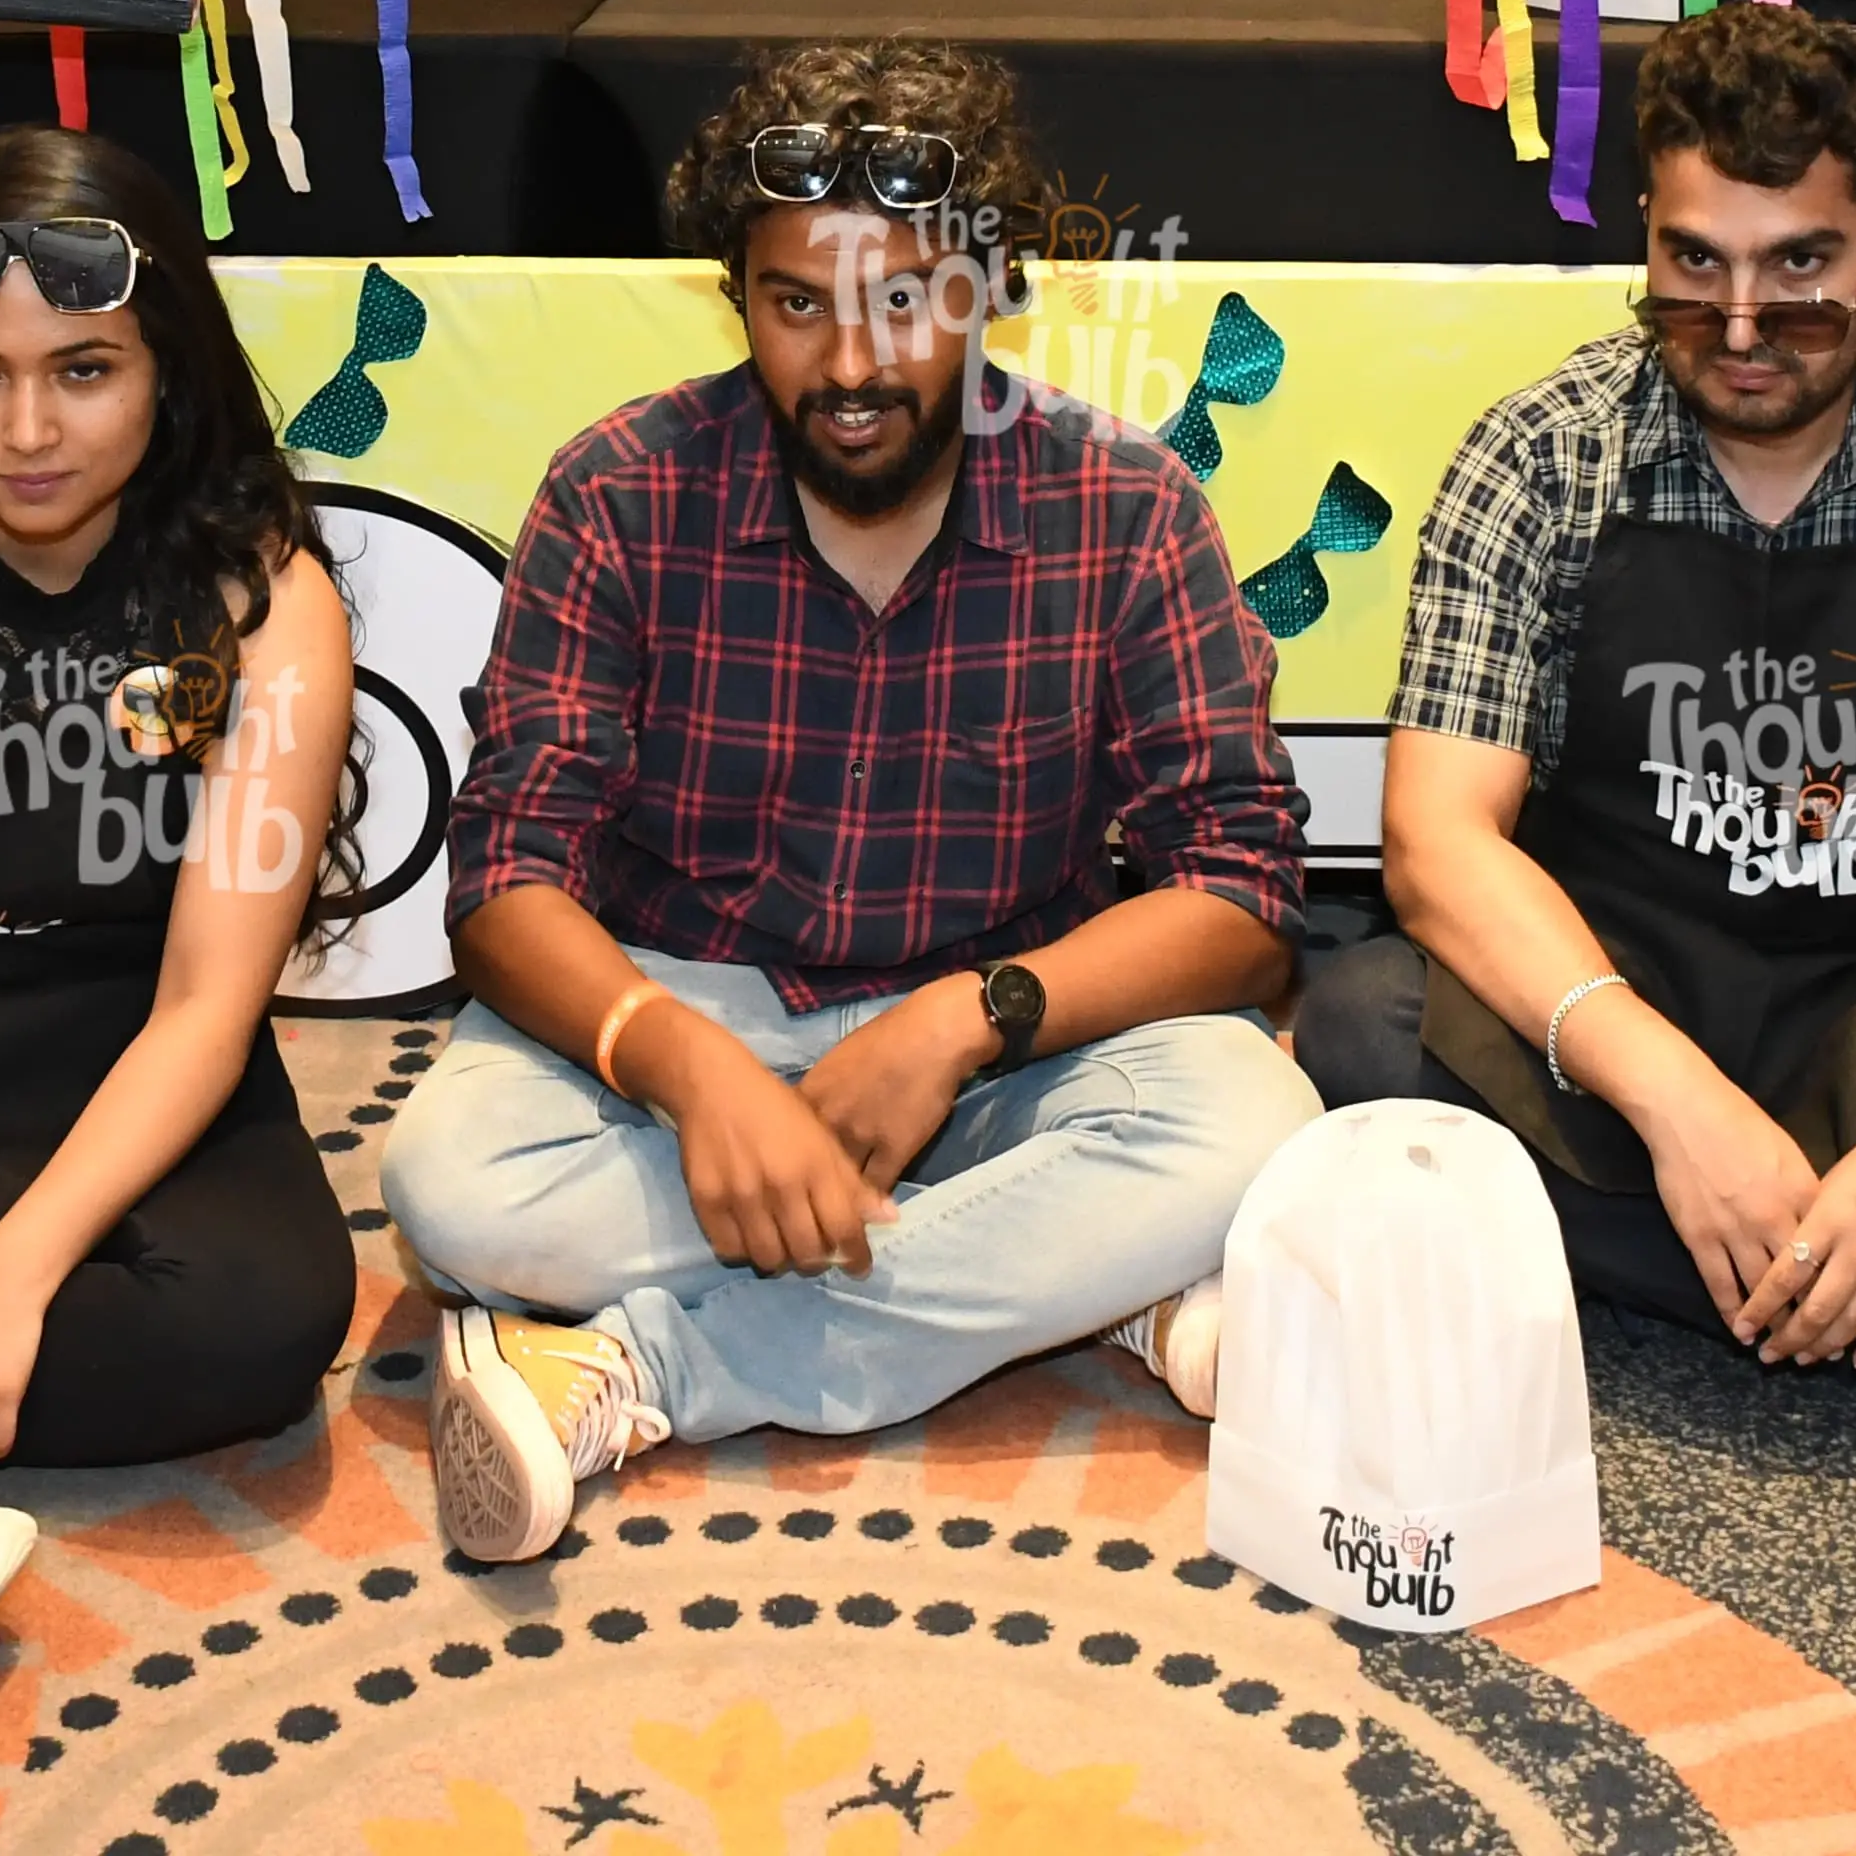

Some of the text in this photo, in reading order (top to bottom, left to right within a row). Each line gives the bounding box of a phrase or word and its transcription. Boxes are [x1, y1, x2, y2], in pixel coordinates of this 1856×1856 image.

[1704, 771, 1765, 808] the
[1351, 1514, 1382, 1539] the
[1366, 1565, 1455, 1616] bulb
